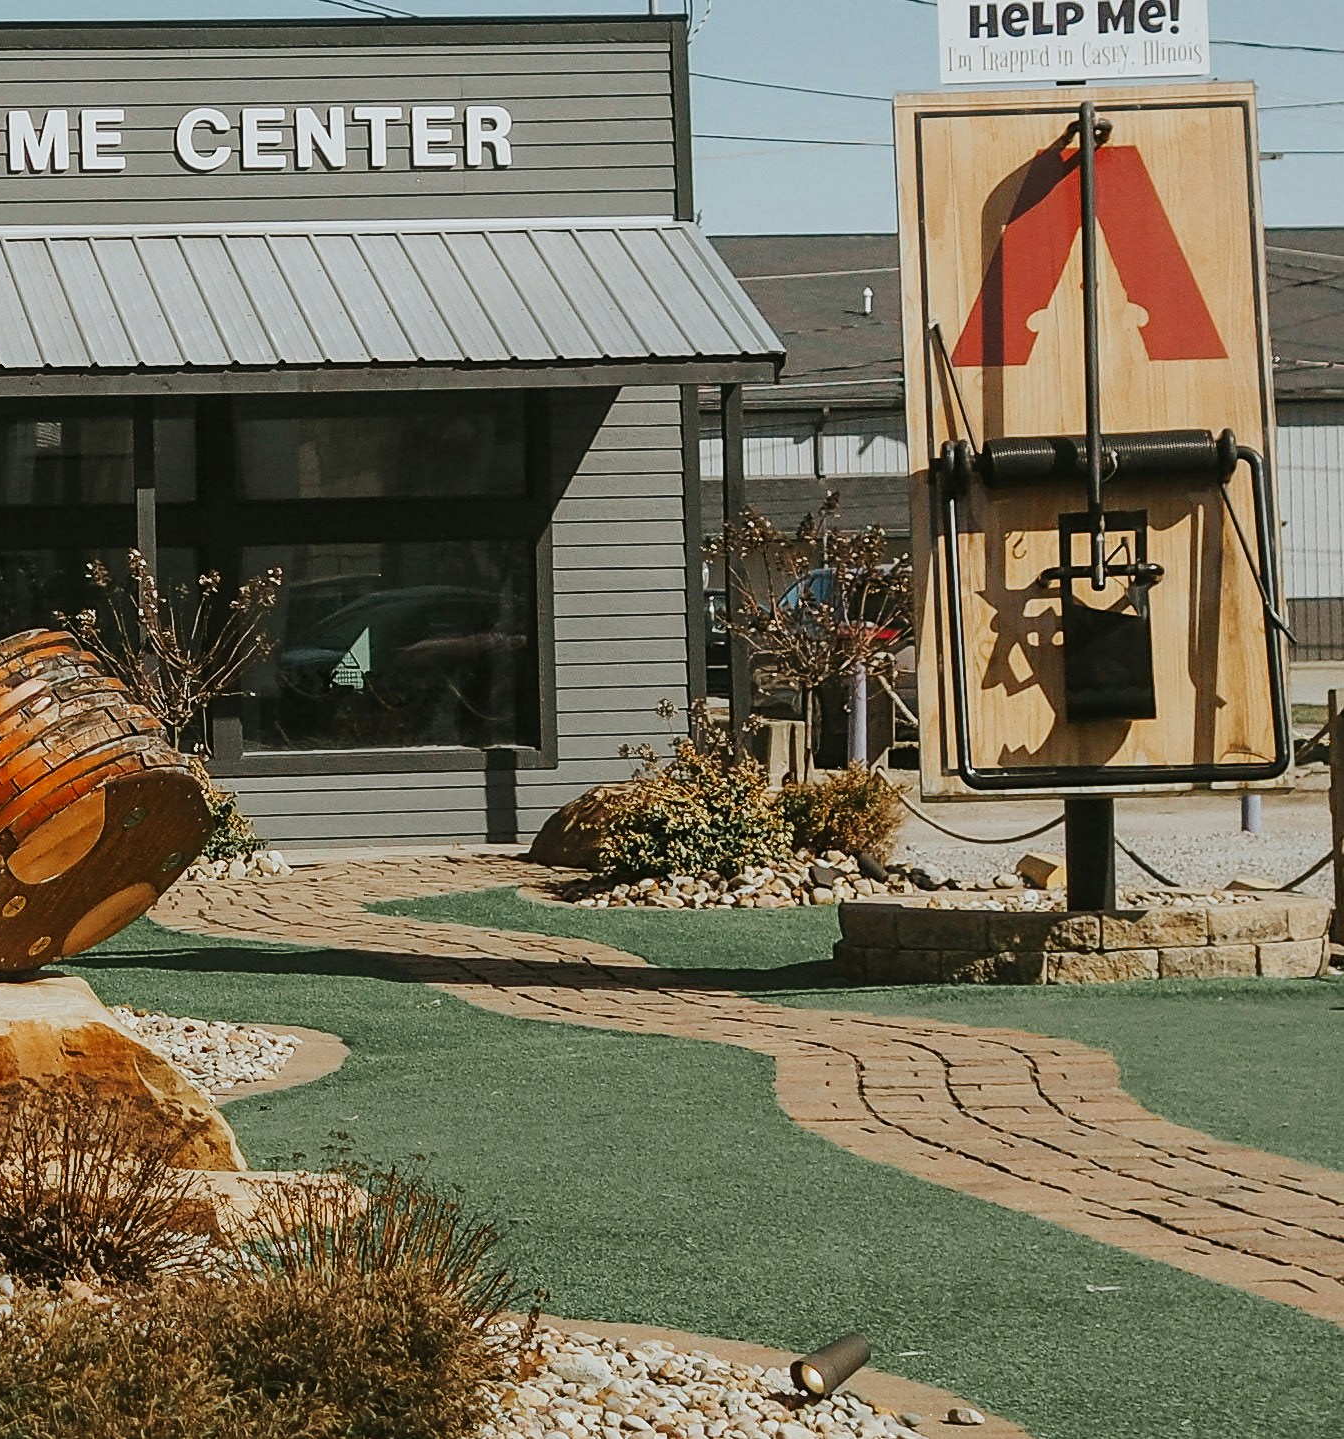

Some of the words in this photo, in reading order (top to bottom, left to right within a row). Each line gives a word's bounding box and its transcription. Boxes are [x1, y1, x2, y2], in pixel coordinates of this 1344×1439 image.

[1058, 45, 1073, 65] in
[1144, 39, 1204, 65] Illinois
[174, 103, 513, 171] CENTER
